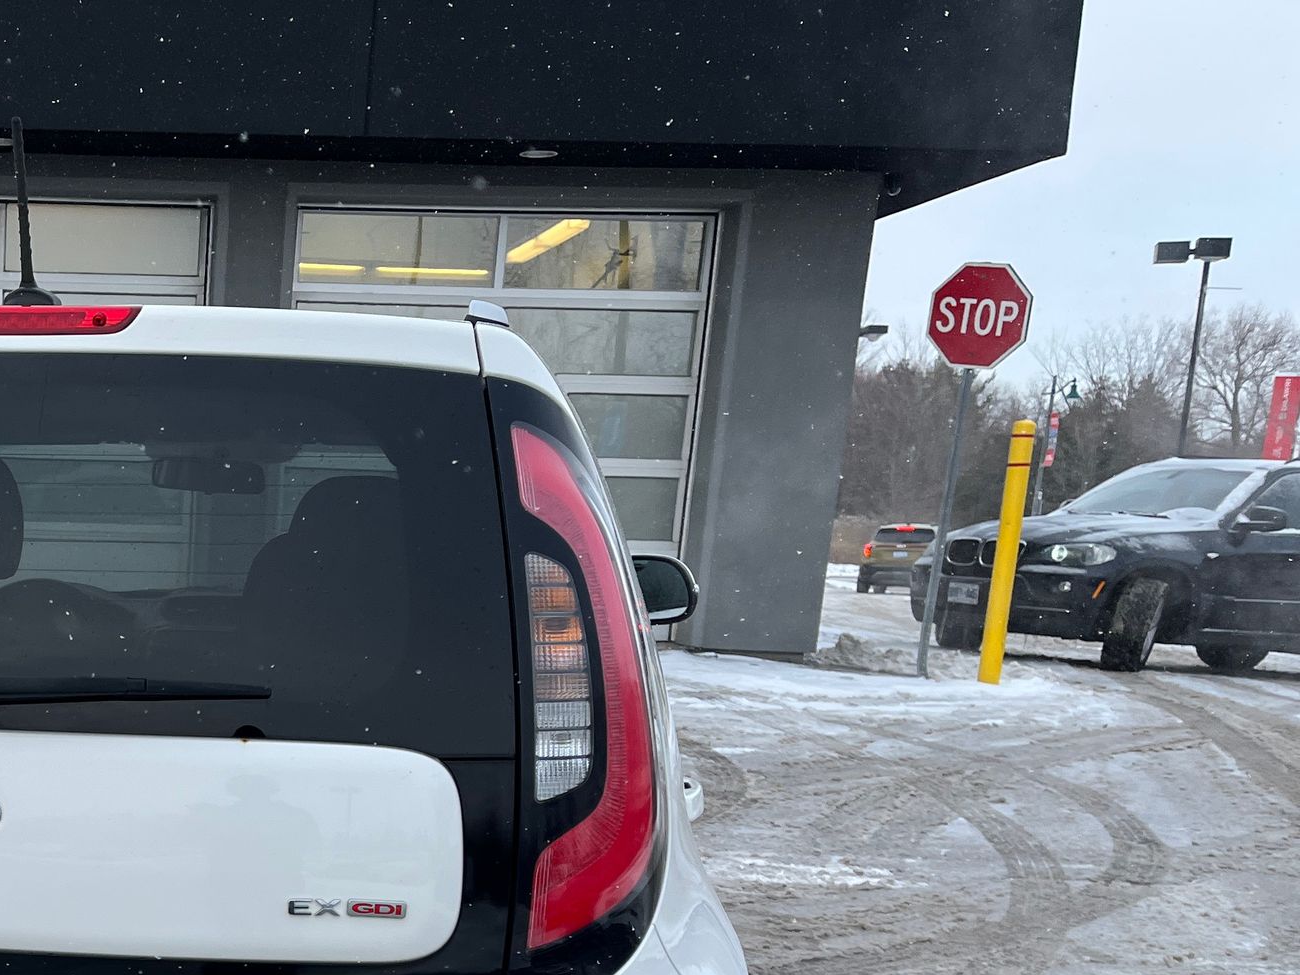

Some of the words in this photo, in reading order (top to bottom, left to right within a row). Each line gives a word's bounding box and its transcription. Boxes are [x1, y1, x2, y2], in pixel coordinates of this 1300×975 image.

[936, 296, 1019, 336] STOP
[287, 898, 341, 917] EX
[351, 902, 402, 916] GDI
